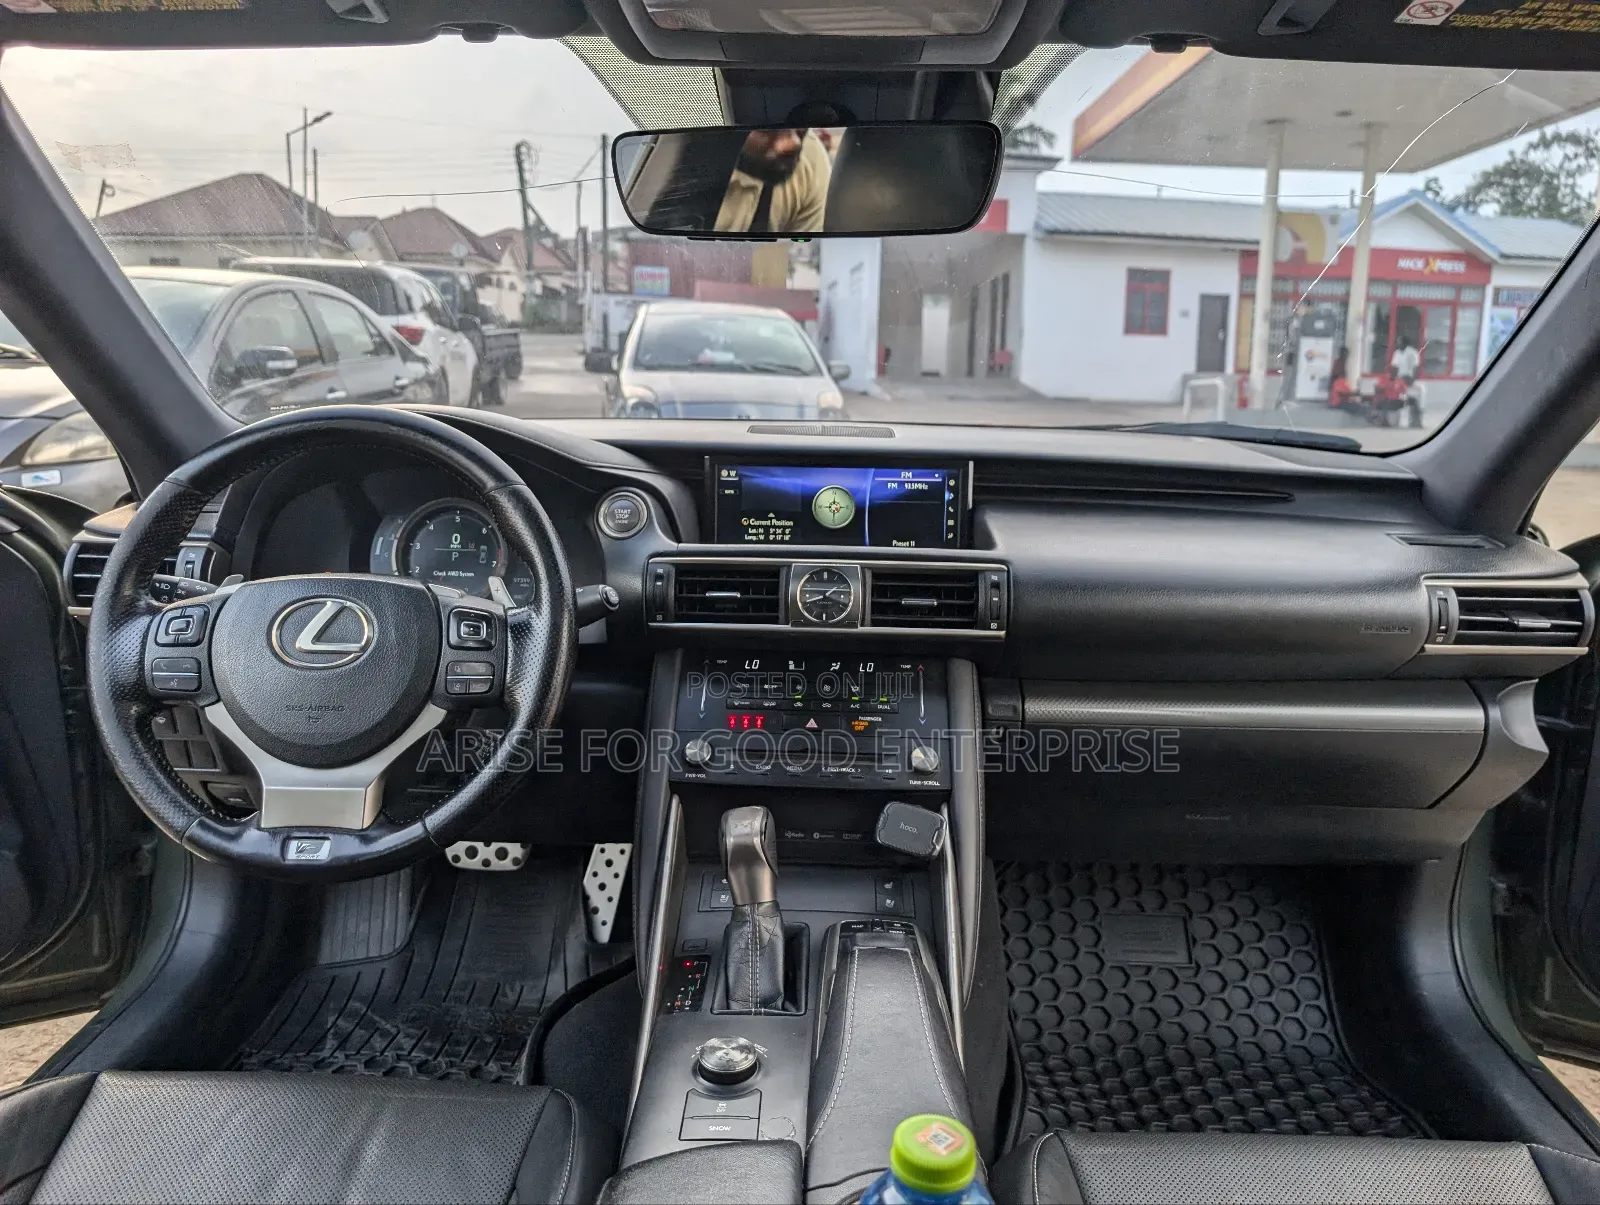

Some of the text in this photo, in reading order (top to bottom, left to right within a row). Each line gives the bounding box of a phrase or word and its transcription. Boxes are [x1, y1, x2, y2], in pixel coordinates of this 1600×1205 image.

[901, 471, 912, 479] FM
[455, 515, 461, 523] 5
[749, 518, 794, 527] Current Position
[482, 527, 488, 535] 6
[452, 533, 461, 545] 0
[892, 539, 910, 547] Preset
[415, 542, 421, 550] 3
[452, 551, 459, 562] P
[491, 560, 497, 568] 7
